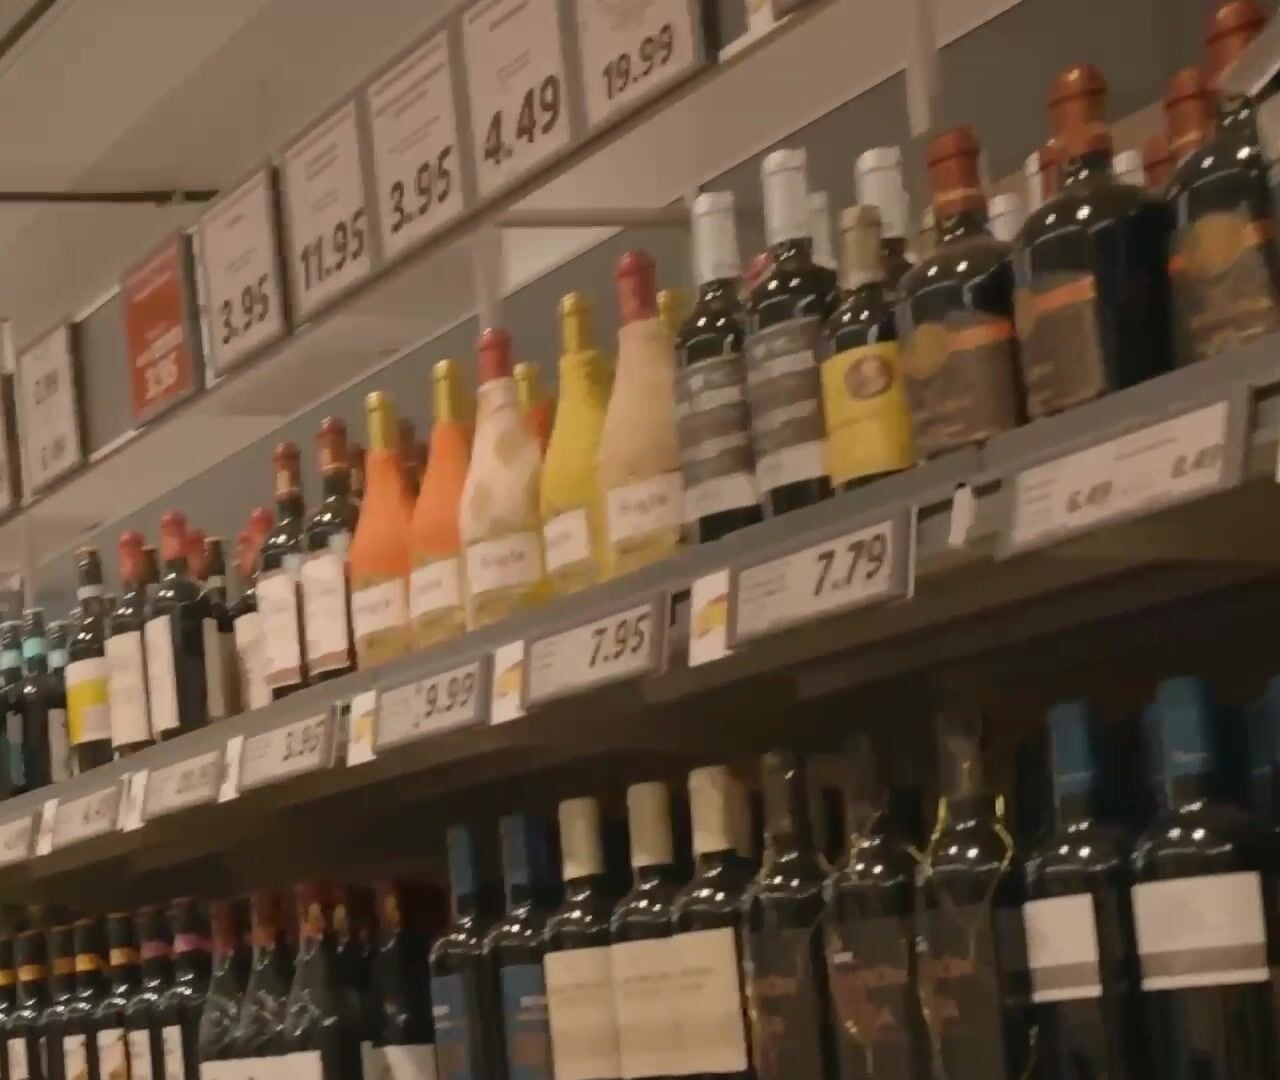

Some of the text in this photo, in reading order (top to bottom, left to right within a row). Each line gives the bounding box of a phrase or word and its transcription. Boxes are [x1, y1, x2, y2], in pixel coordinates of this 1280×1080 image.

[603, 23, 672, 100] 19.99
[484, 74, 561, 164] 4.49
[391, 144, 452, 234] 3.95
[301, 206, 365, 291] 11.95
[221, 273, 269, 345] 3.95
[813, 533, 887, 596] 7.79
[589, 614, 647, 668] 7.95
